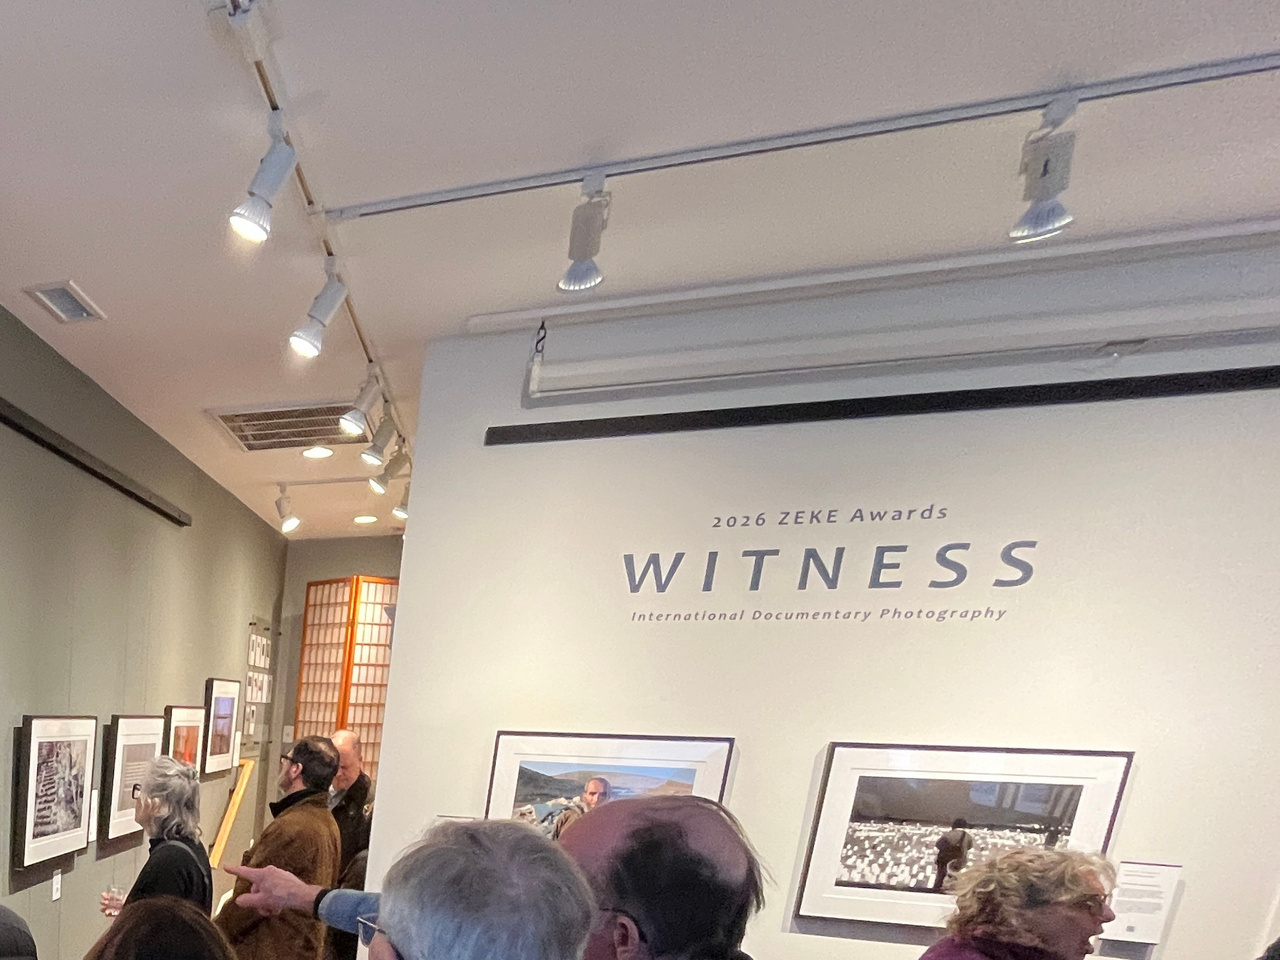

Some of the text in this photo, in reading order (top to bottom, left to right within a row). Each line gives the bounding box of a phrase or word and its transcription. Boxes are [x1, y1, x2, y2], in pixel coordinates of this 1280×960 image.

[711, 504, 949, 528] 2026 ZEKE Awards
[622, 539, 1039, 594] WITNESS
[630, 606, 1008, 623] International Documentary Photography
